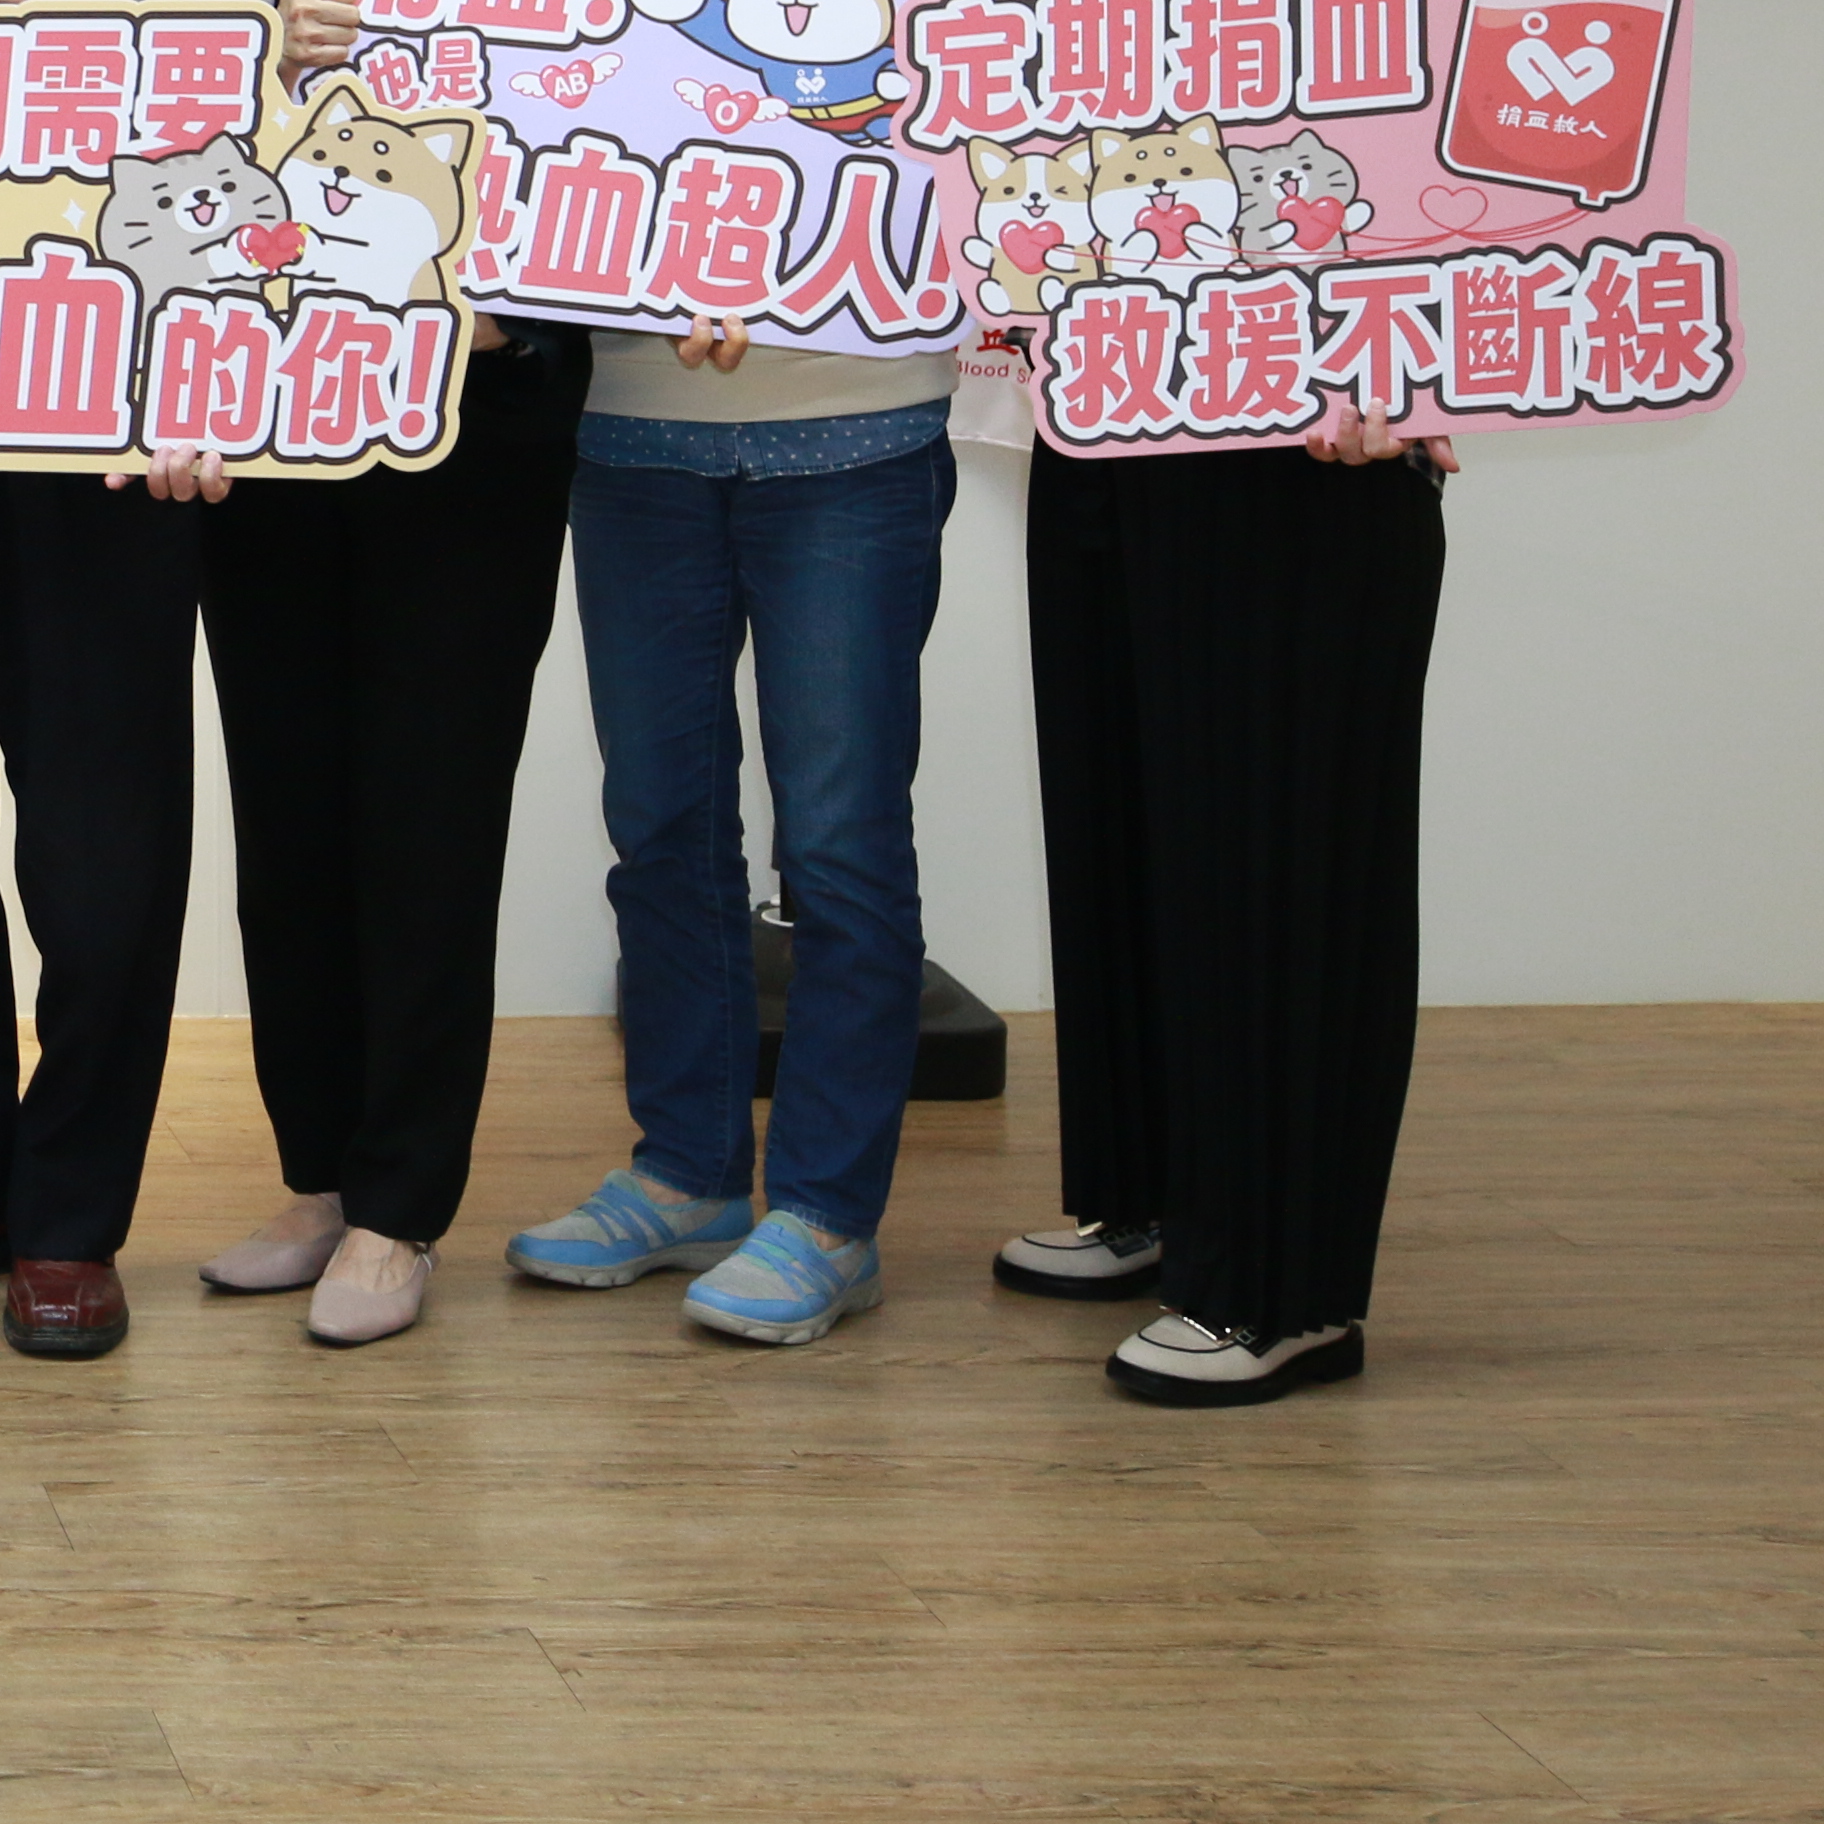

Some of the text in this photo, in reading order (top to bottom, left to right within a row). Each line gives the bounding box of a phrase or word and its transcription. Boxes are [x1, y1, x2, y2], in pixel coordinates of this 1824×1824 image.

[553, 72, 588, 99] AB
[715, 100, 740, 126] O
[1496, 102, 1608, 141] 捐血救人
[1061, 251, 1715, 430] 救援不斷線
